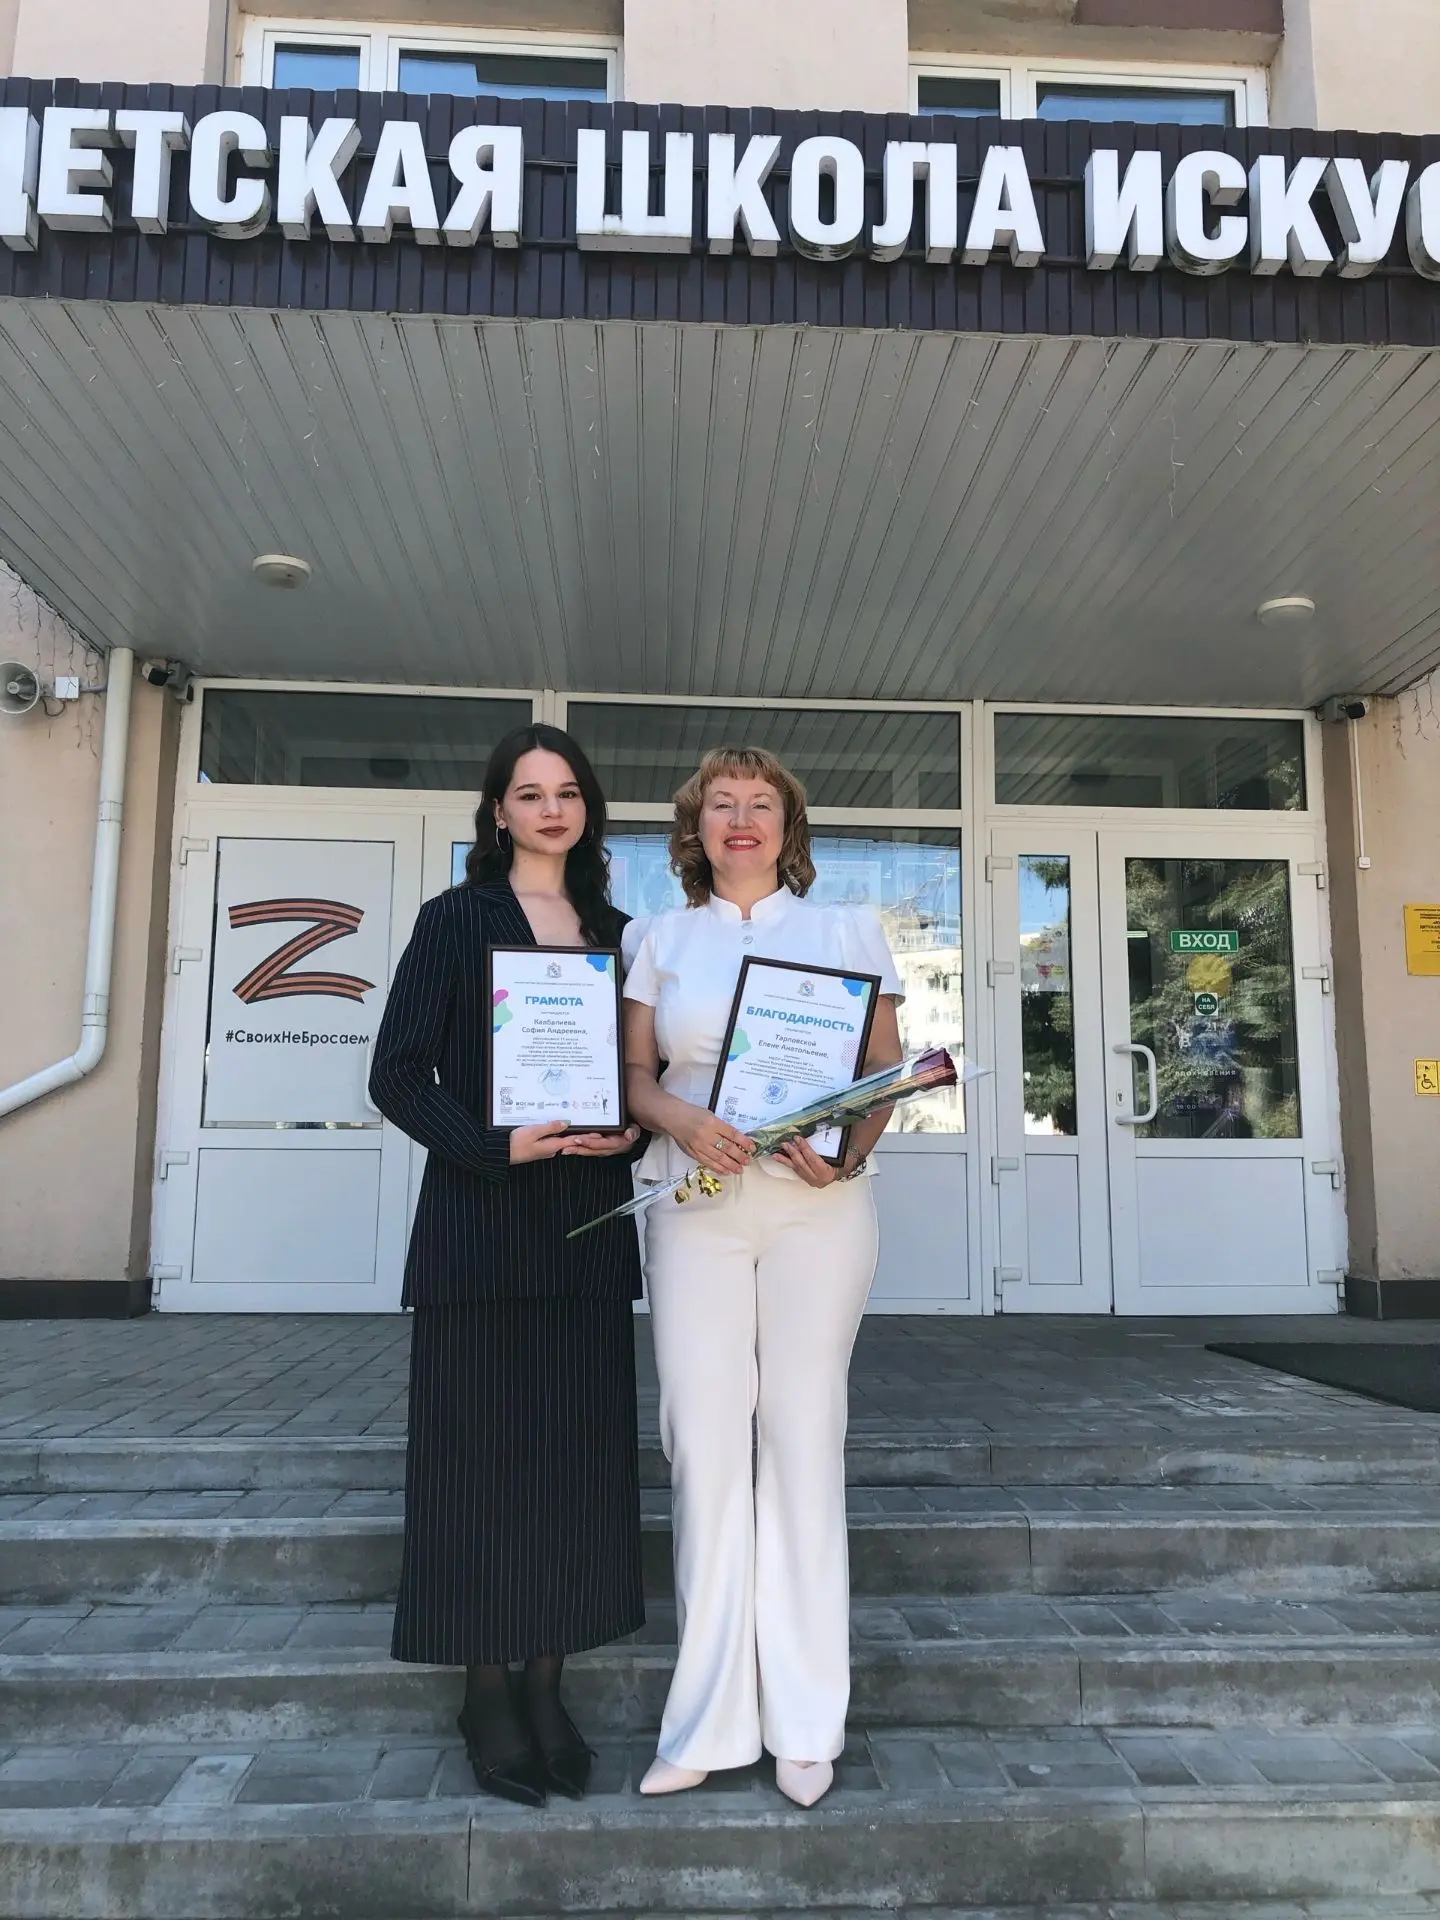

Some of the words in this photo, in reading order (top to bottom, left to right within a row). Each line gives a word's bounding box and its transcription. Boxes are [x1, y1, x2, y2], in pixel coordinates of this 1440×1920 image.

[576, 129, 1046, 262] ШКОЛА
[1179, 933, 1231, 950] ВХОД
[525, 995, 584, 1007] ГРАМОТА
[746, 1006, 855, 1033] БЛАГОДАРНОСТЬ
[225, 1029, 370, 1047] #СвоихНеБросаем
[758, 1040, 780, 1050] Елене
